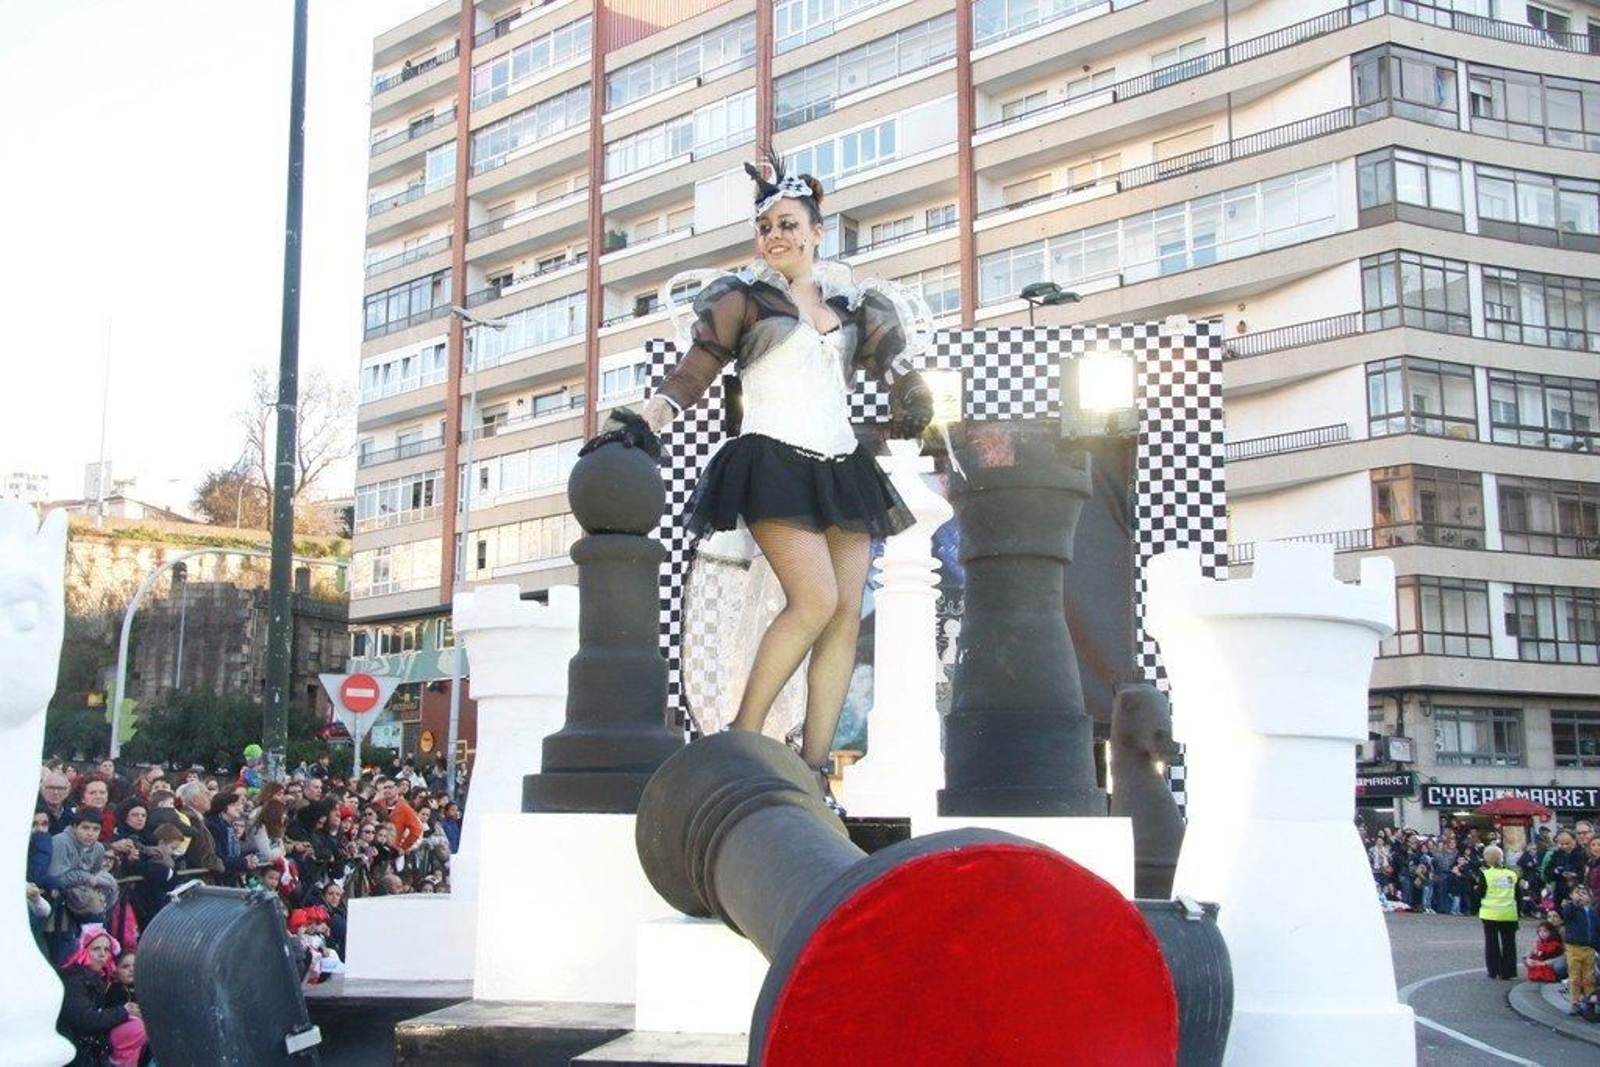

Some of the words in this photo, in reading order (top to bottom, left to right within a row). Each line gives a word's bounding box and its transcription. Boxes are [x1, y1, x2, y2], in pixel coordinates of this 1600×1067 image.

[1364, 775, 1410, 786] MARKET
[1428, 786, 1494, 805] CYBER
[1515, 788, 1598, 807] MARKET
